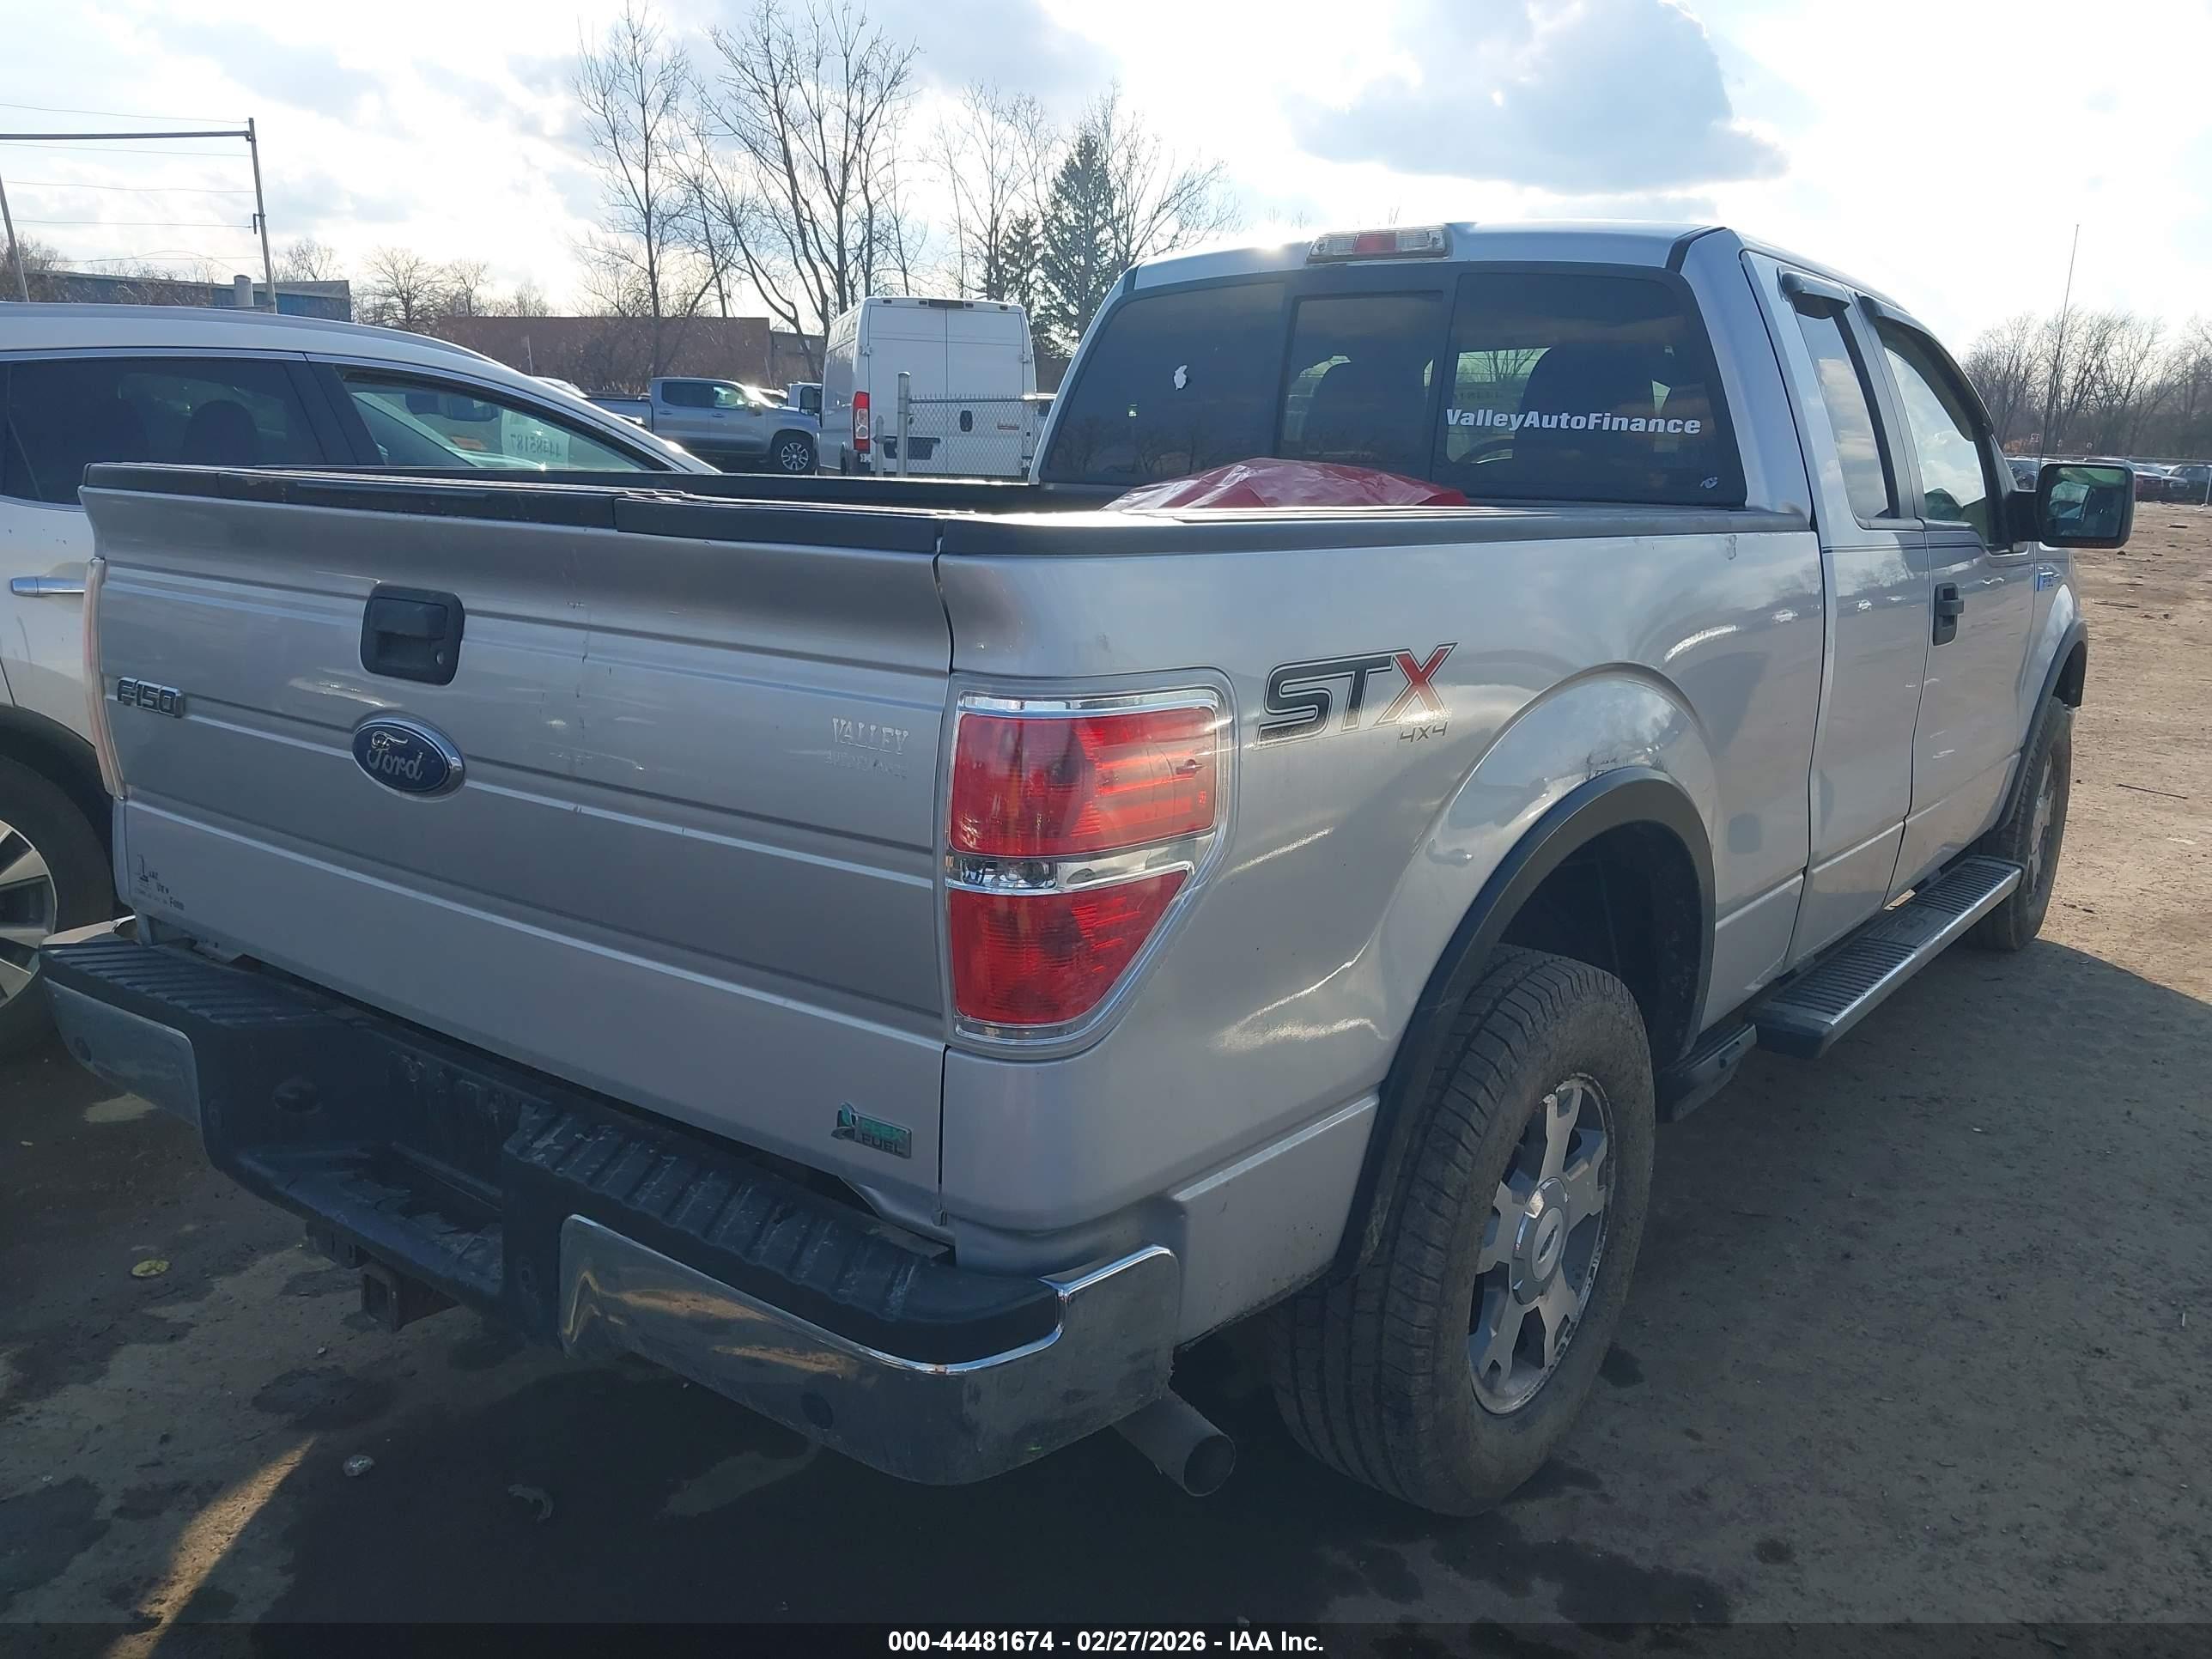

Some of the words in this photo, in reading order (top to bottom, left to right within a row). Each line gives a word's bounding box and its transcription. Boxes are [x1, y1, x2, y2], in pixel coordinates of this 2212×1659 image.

[1446, 408, 1701, 434] ValleyAutoFinance
[1254, 641, 1460, 749] STX
[366, 730, 426, 781] Ford
